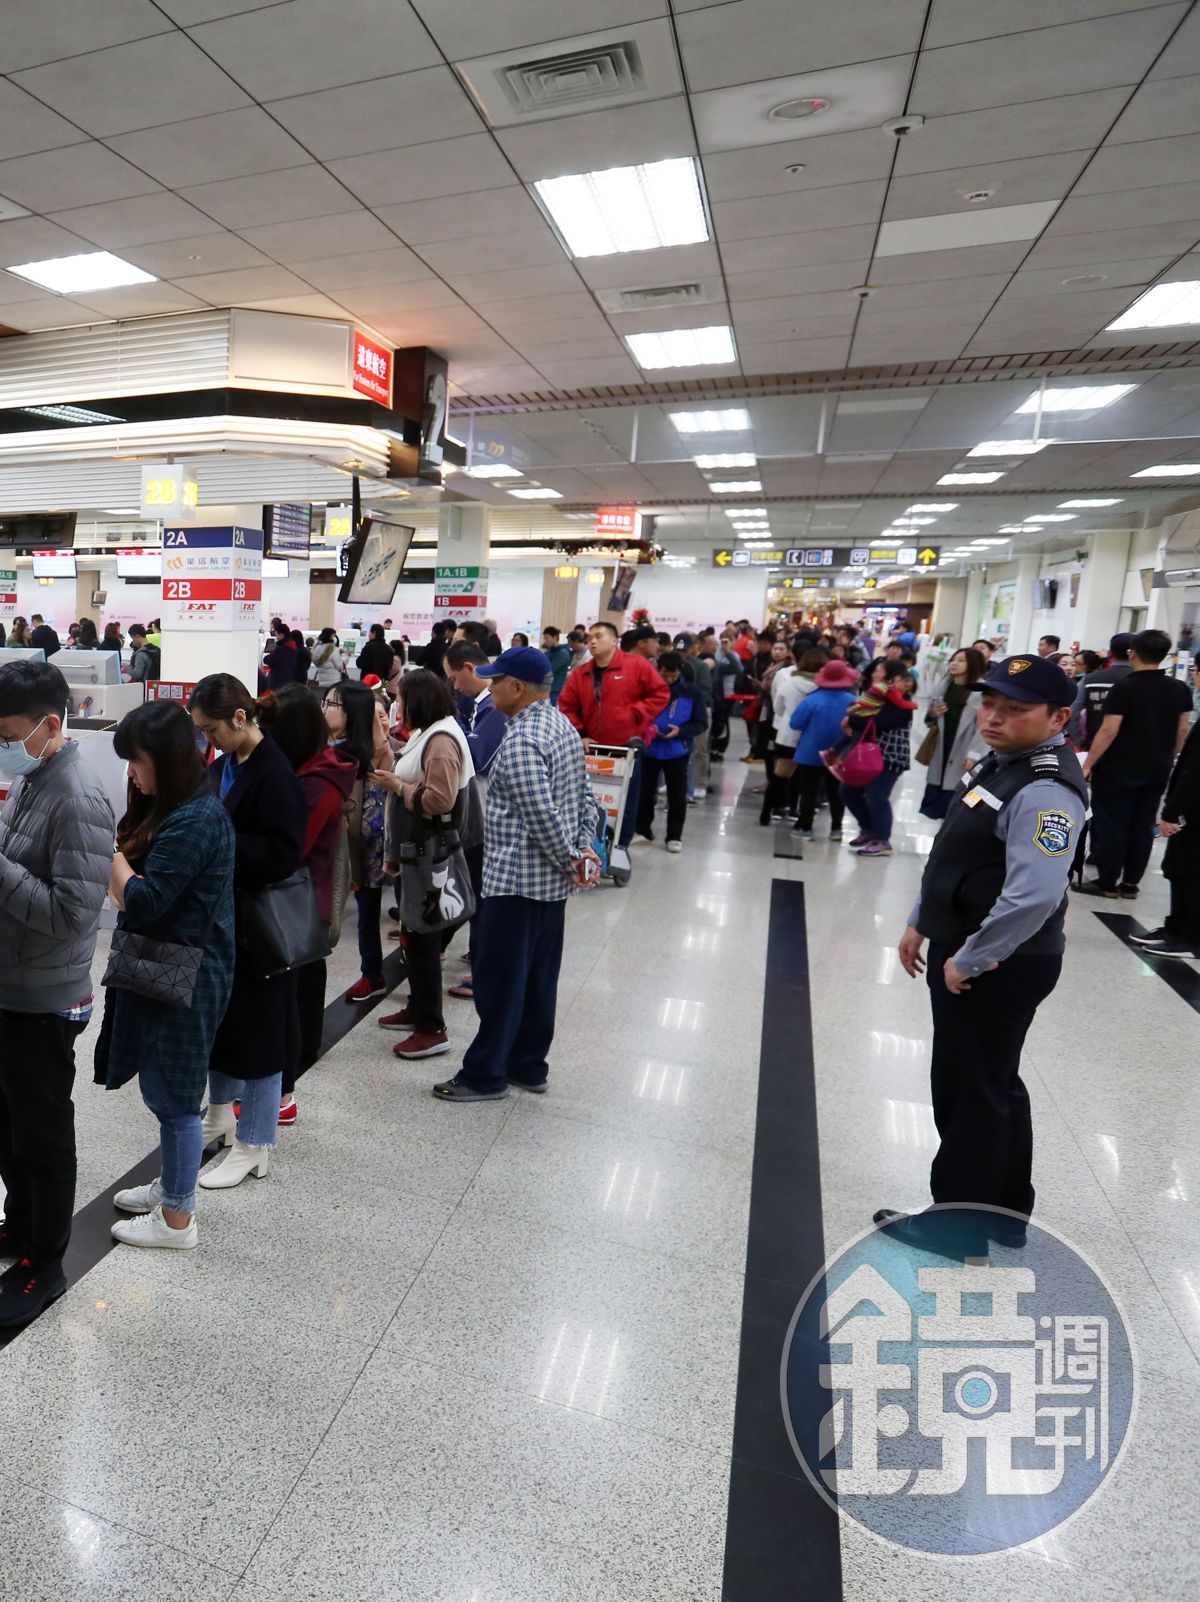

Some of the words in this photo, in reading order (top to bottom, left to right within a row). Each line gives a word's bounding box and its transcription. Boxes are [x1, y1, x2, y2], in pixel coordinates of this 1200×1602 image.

[146, 479, 175, 506] 2B
[329, 516, 352, 537] 2A
[166, 531, 188, 546] 2A
[235, 530, 245, 546] 2A
[438, 567, 468, 577] 1A.1B
[167, 581, 192, 598] 2B
[234, 581, 246, 598] 2B
[243, 603, 256, 611] FAT
[436, 597, 450, 606] 1B
[1043, 821, 1070, 833] SECURITY
